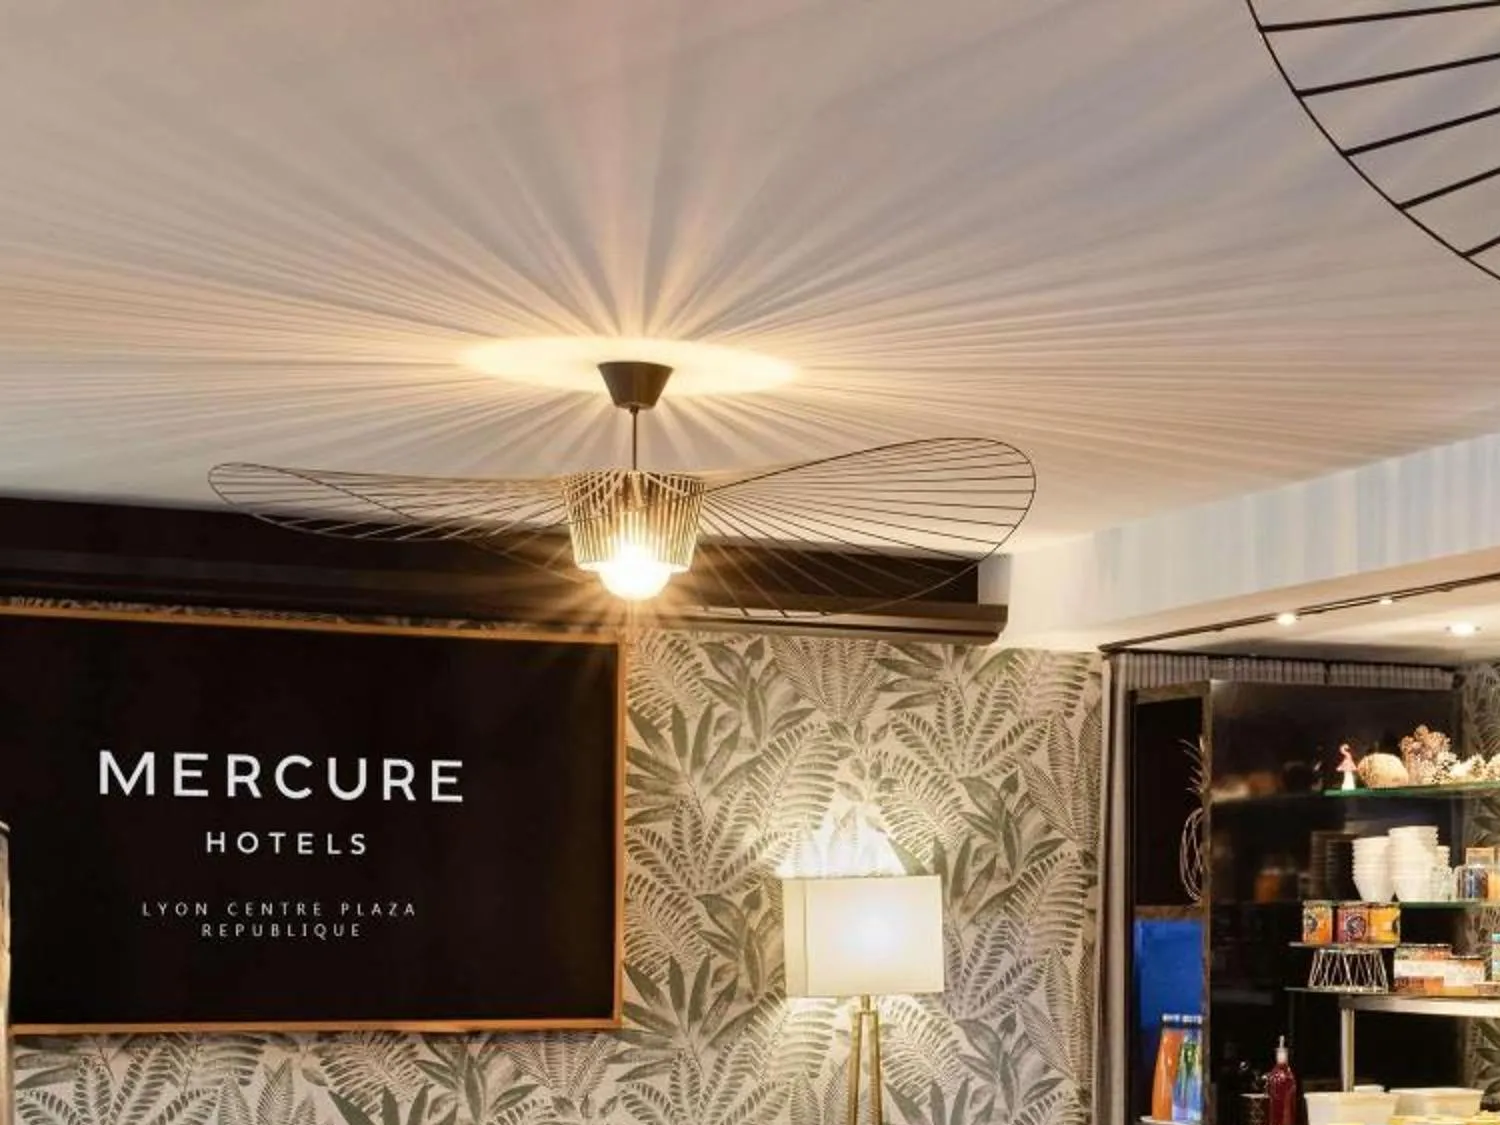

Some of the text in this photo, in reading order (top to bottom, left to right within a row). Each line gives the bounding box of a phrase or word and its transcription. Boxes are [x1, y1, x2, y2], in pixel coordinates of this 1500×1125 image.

[99, 750, 464, 803] MERCURE
[206, 831, 367, 855] HOTELS
[142, 902, 416, 917] LYON CENTRE PLAZA
[202, 923, 361, 941] REPUBLIQUE
